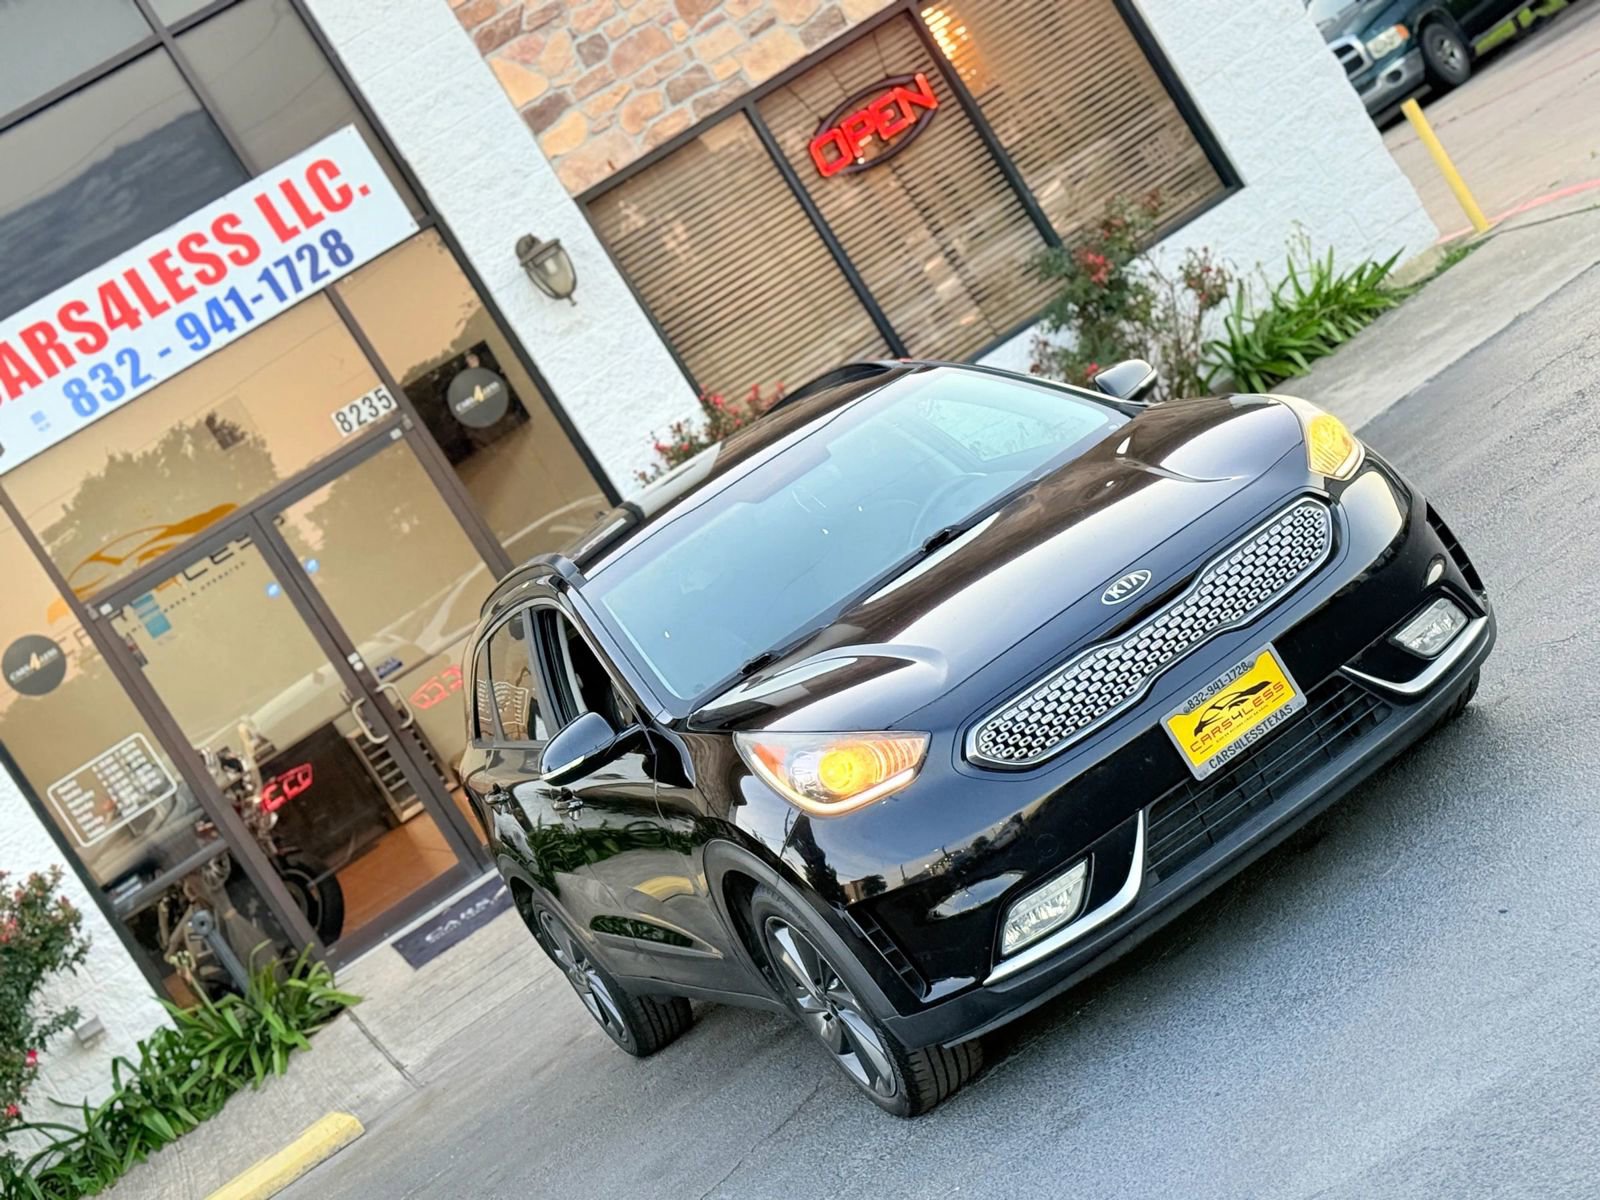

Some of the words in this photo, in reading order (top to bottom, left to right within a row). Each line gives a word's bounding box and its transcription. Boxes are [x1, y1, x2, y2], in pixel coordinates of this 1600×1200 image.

[809, 73, 938, 177] OPEN
[0, 213, 260, 406] ARS4LESS
[255, 160, 370, 244] LLC.
[63, 347, 153, 418] 832
[175, 229, 354, 353] 941-1728
[336, 389, 393, 433] 8235
[1106, 574, 1146, 599] KIA
[1187, 661, 1249, 709] 832-941-1728
[1190, 681, 1284, 753] CARS4LESS
[1209, 704, 1293, 769] CARS4LESSTEXAS
